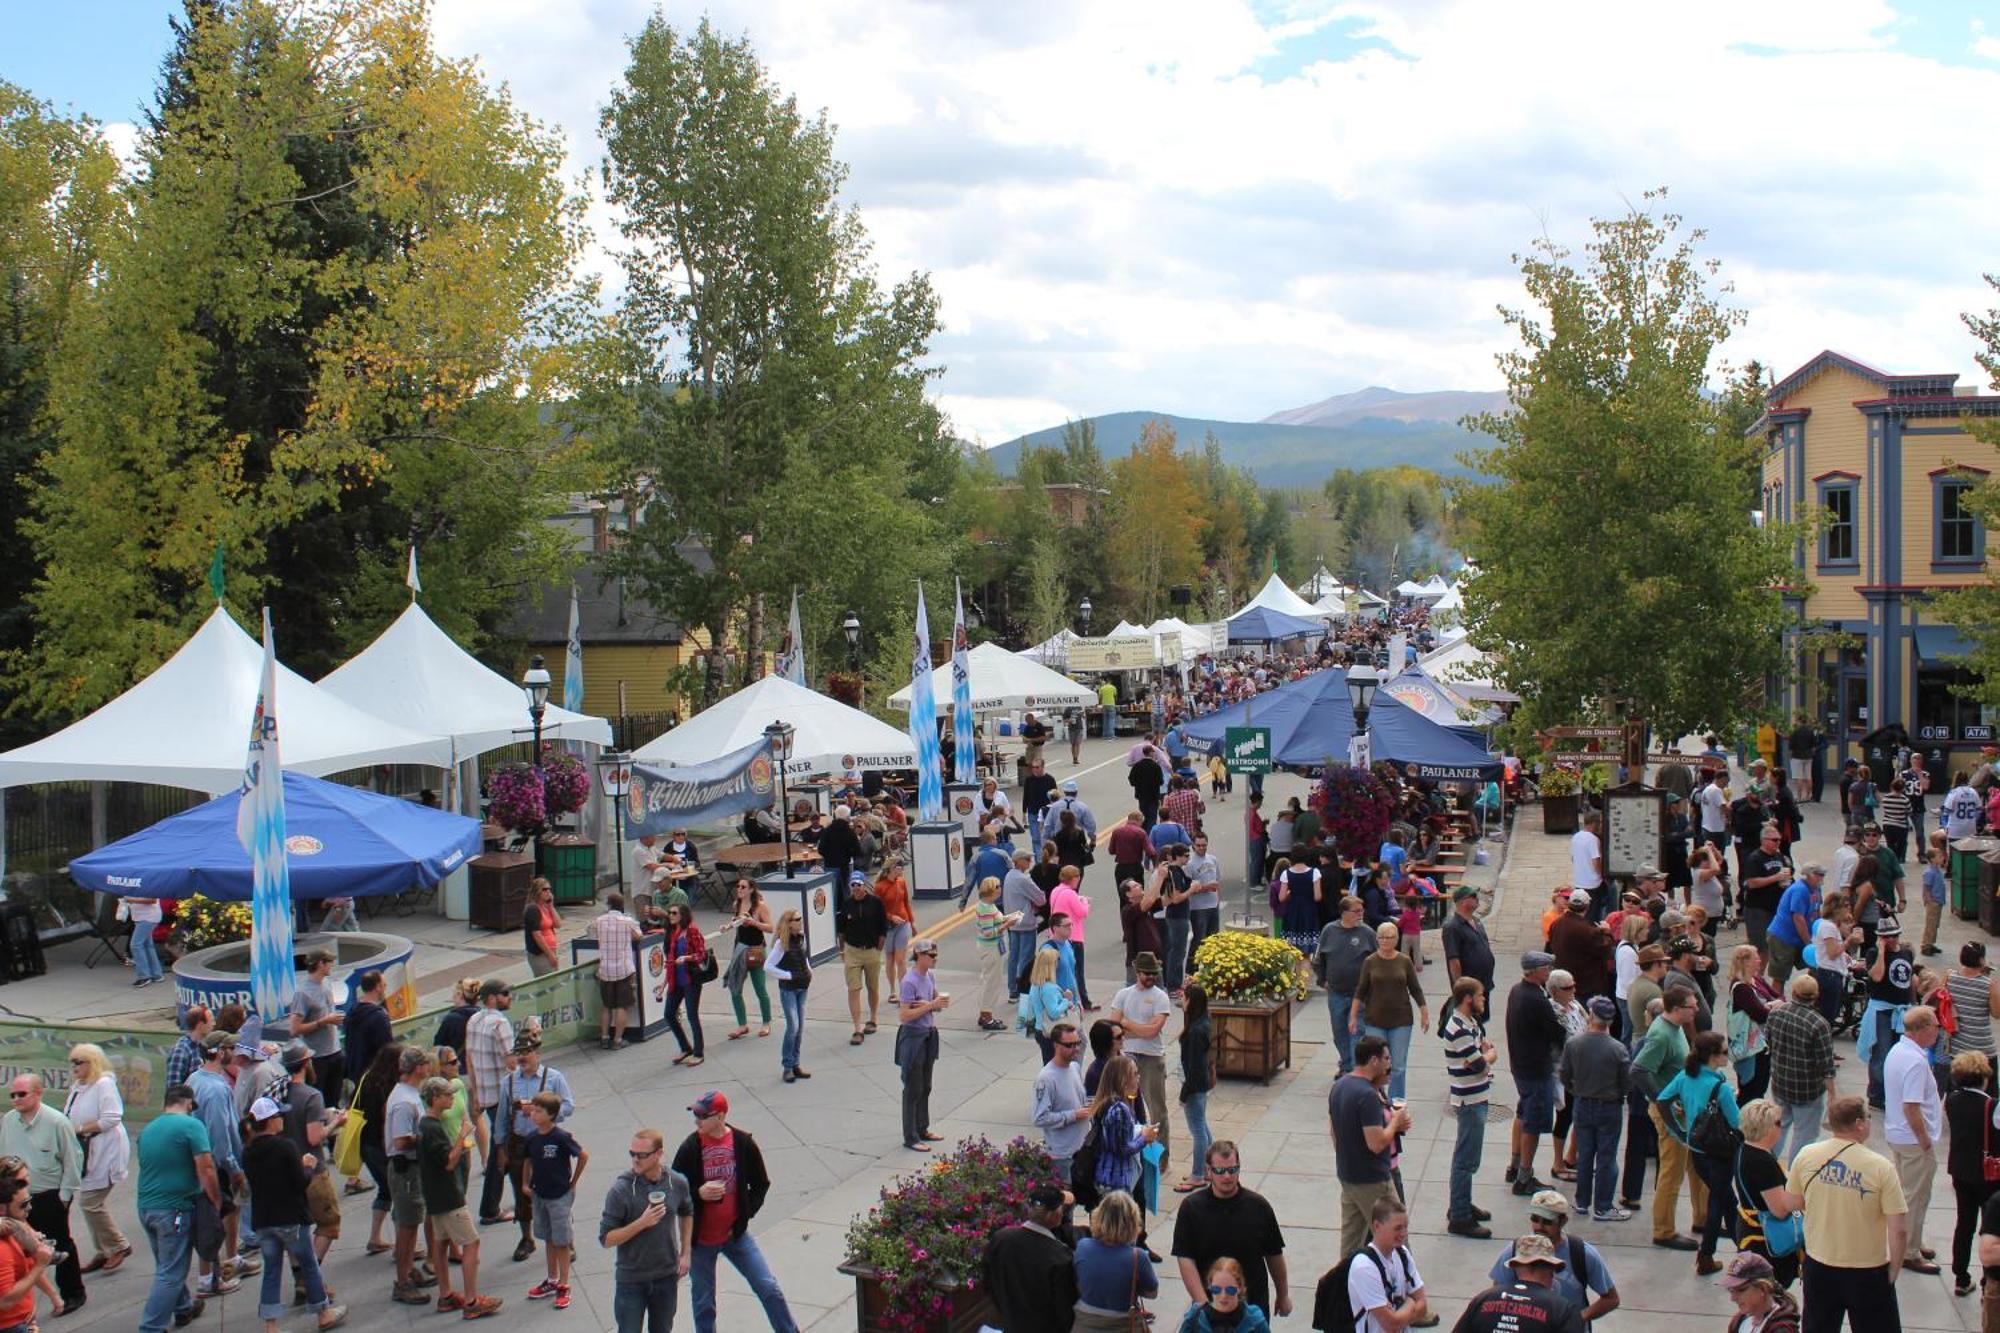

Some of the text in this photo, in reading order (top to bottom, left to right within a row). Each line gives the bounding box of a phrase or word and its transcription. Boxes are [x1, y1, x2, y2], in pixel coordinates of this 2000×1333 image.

[1036, 696, 1080, 705] PAULANER
[1967, 728, 1988, 737] ATM
[856, 755, 914, 767] PAULANER
[1227, 758, 1269, 766] RESTROOMS
[1420, 765, 1481, 779] PAULANER
[646, 770, 746, 813] Willkommen
[1956, 801, 1977, 820] 82
